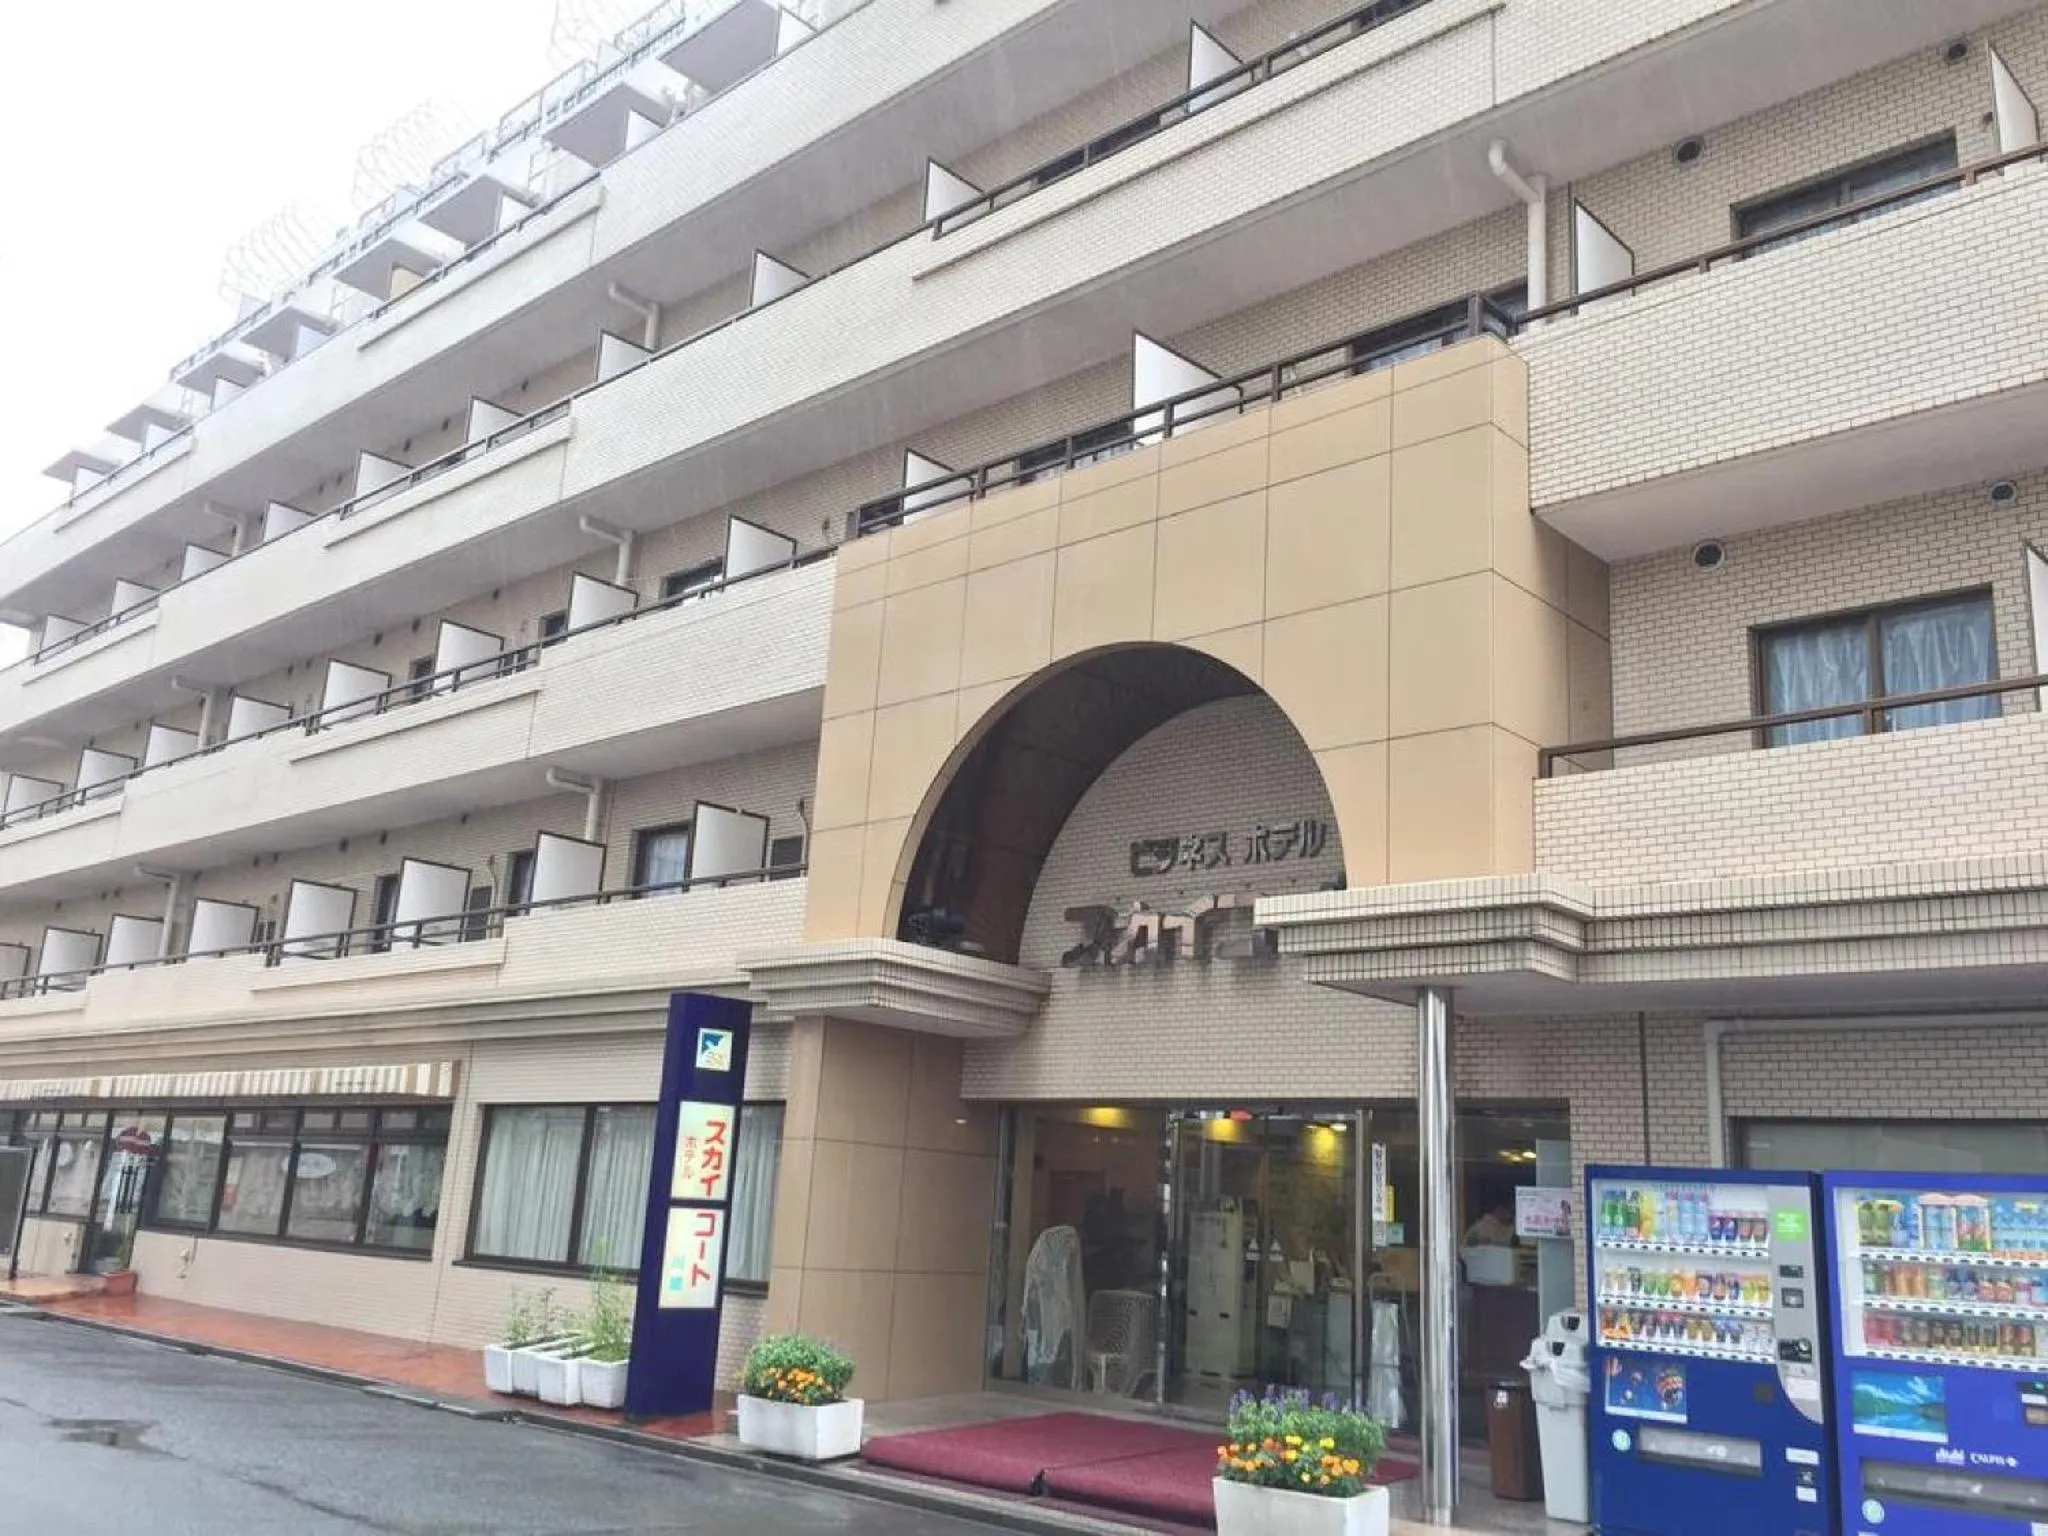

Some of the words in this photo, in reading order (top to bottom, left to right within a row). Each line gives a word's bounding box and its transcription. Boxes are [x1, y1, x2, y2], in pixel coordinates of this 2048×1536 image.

[1130, 831, 1232, 876] ビジネス
[1245, 819, 1327, 865] ホテル
